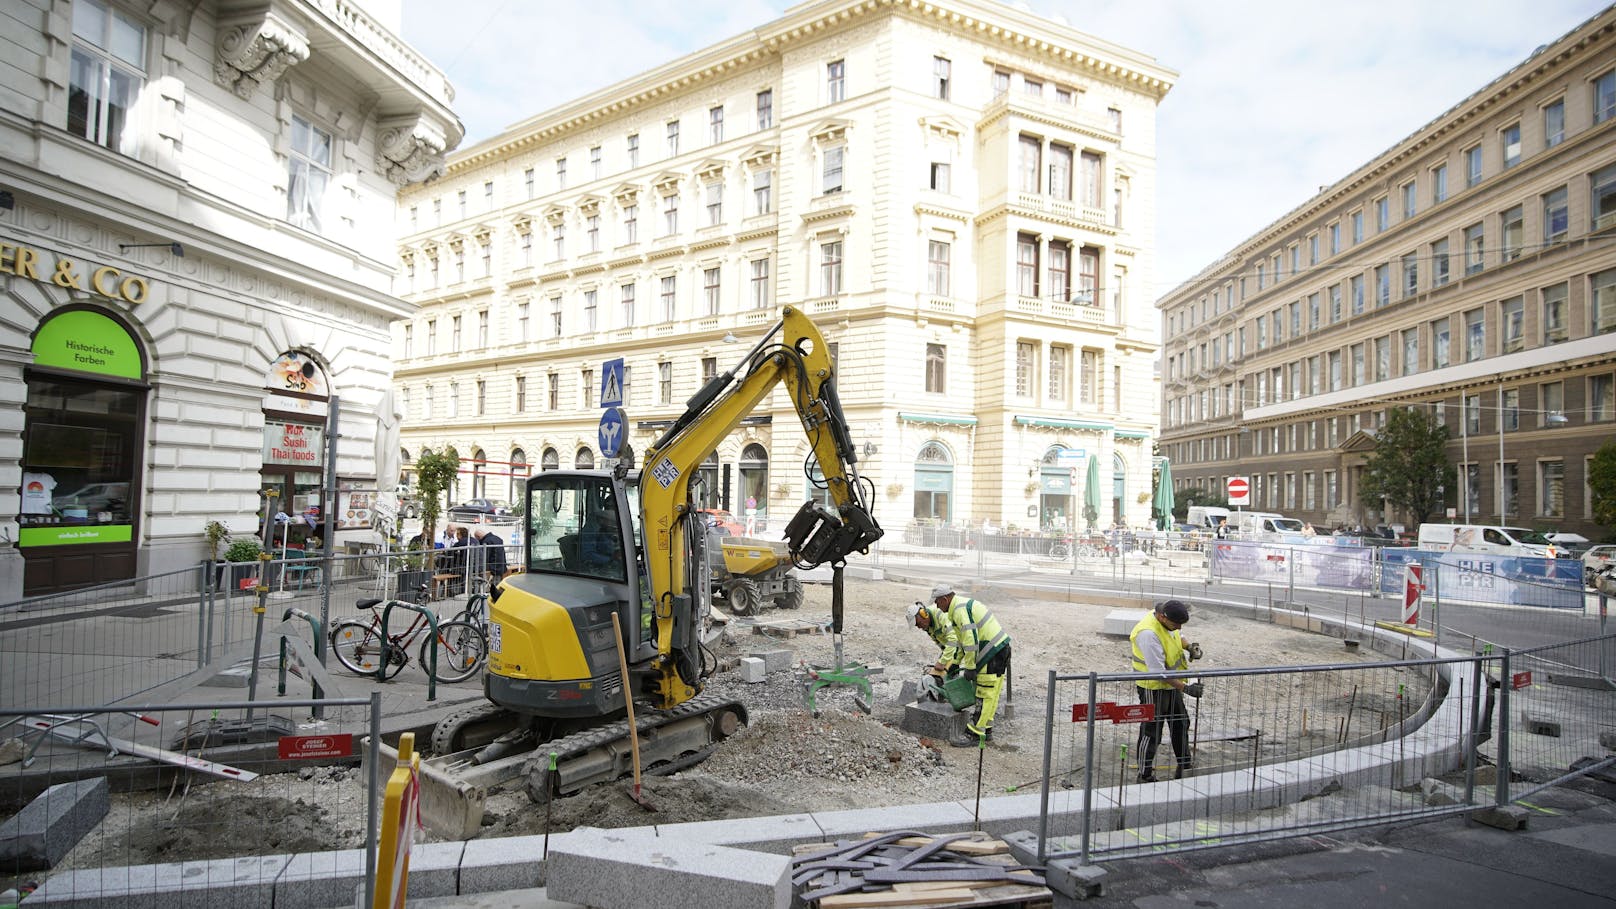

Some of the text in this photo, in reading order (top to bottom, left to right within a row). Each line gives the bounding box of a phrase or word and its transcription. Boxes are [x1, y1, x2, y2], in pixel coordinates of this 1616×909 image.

[53, 259, 81, 290] &
[93, 266, 148, 305] CO
[66, 339, 115, 356] Historische
[74, 353, 106, 366] Farben
[283, 436, 308, 448] Sushi
[271, 448, 315, 461] Thai foods
